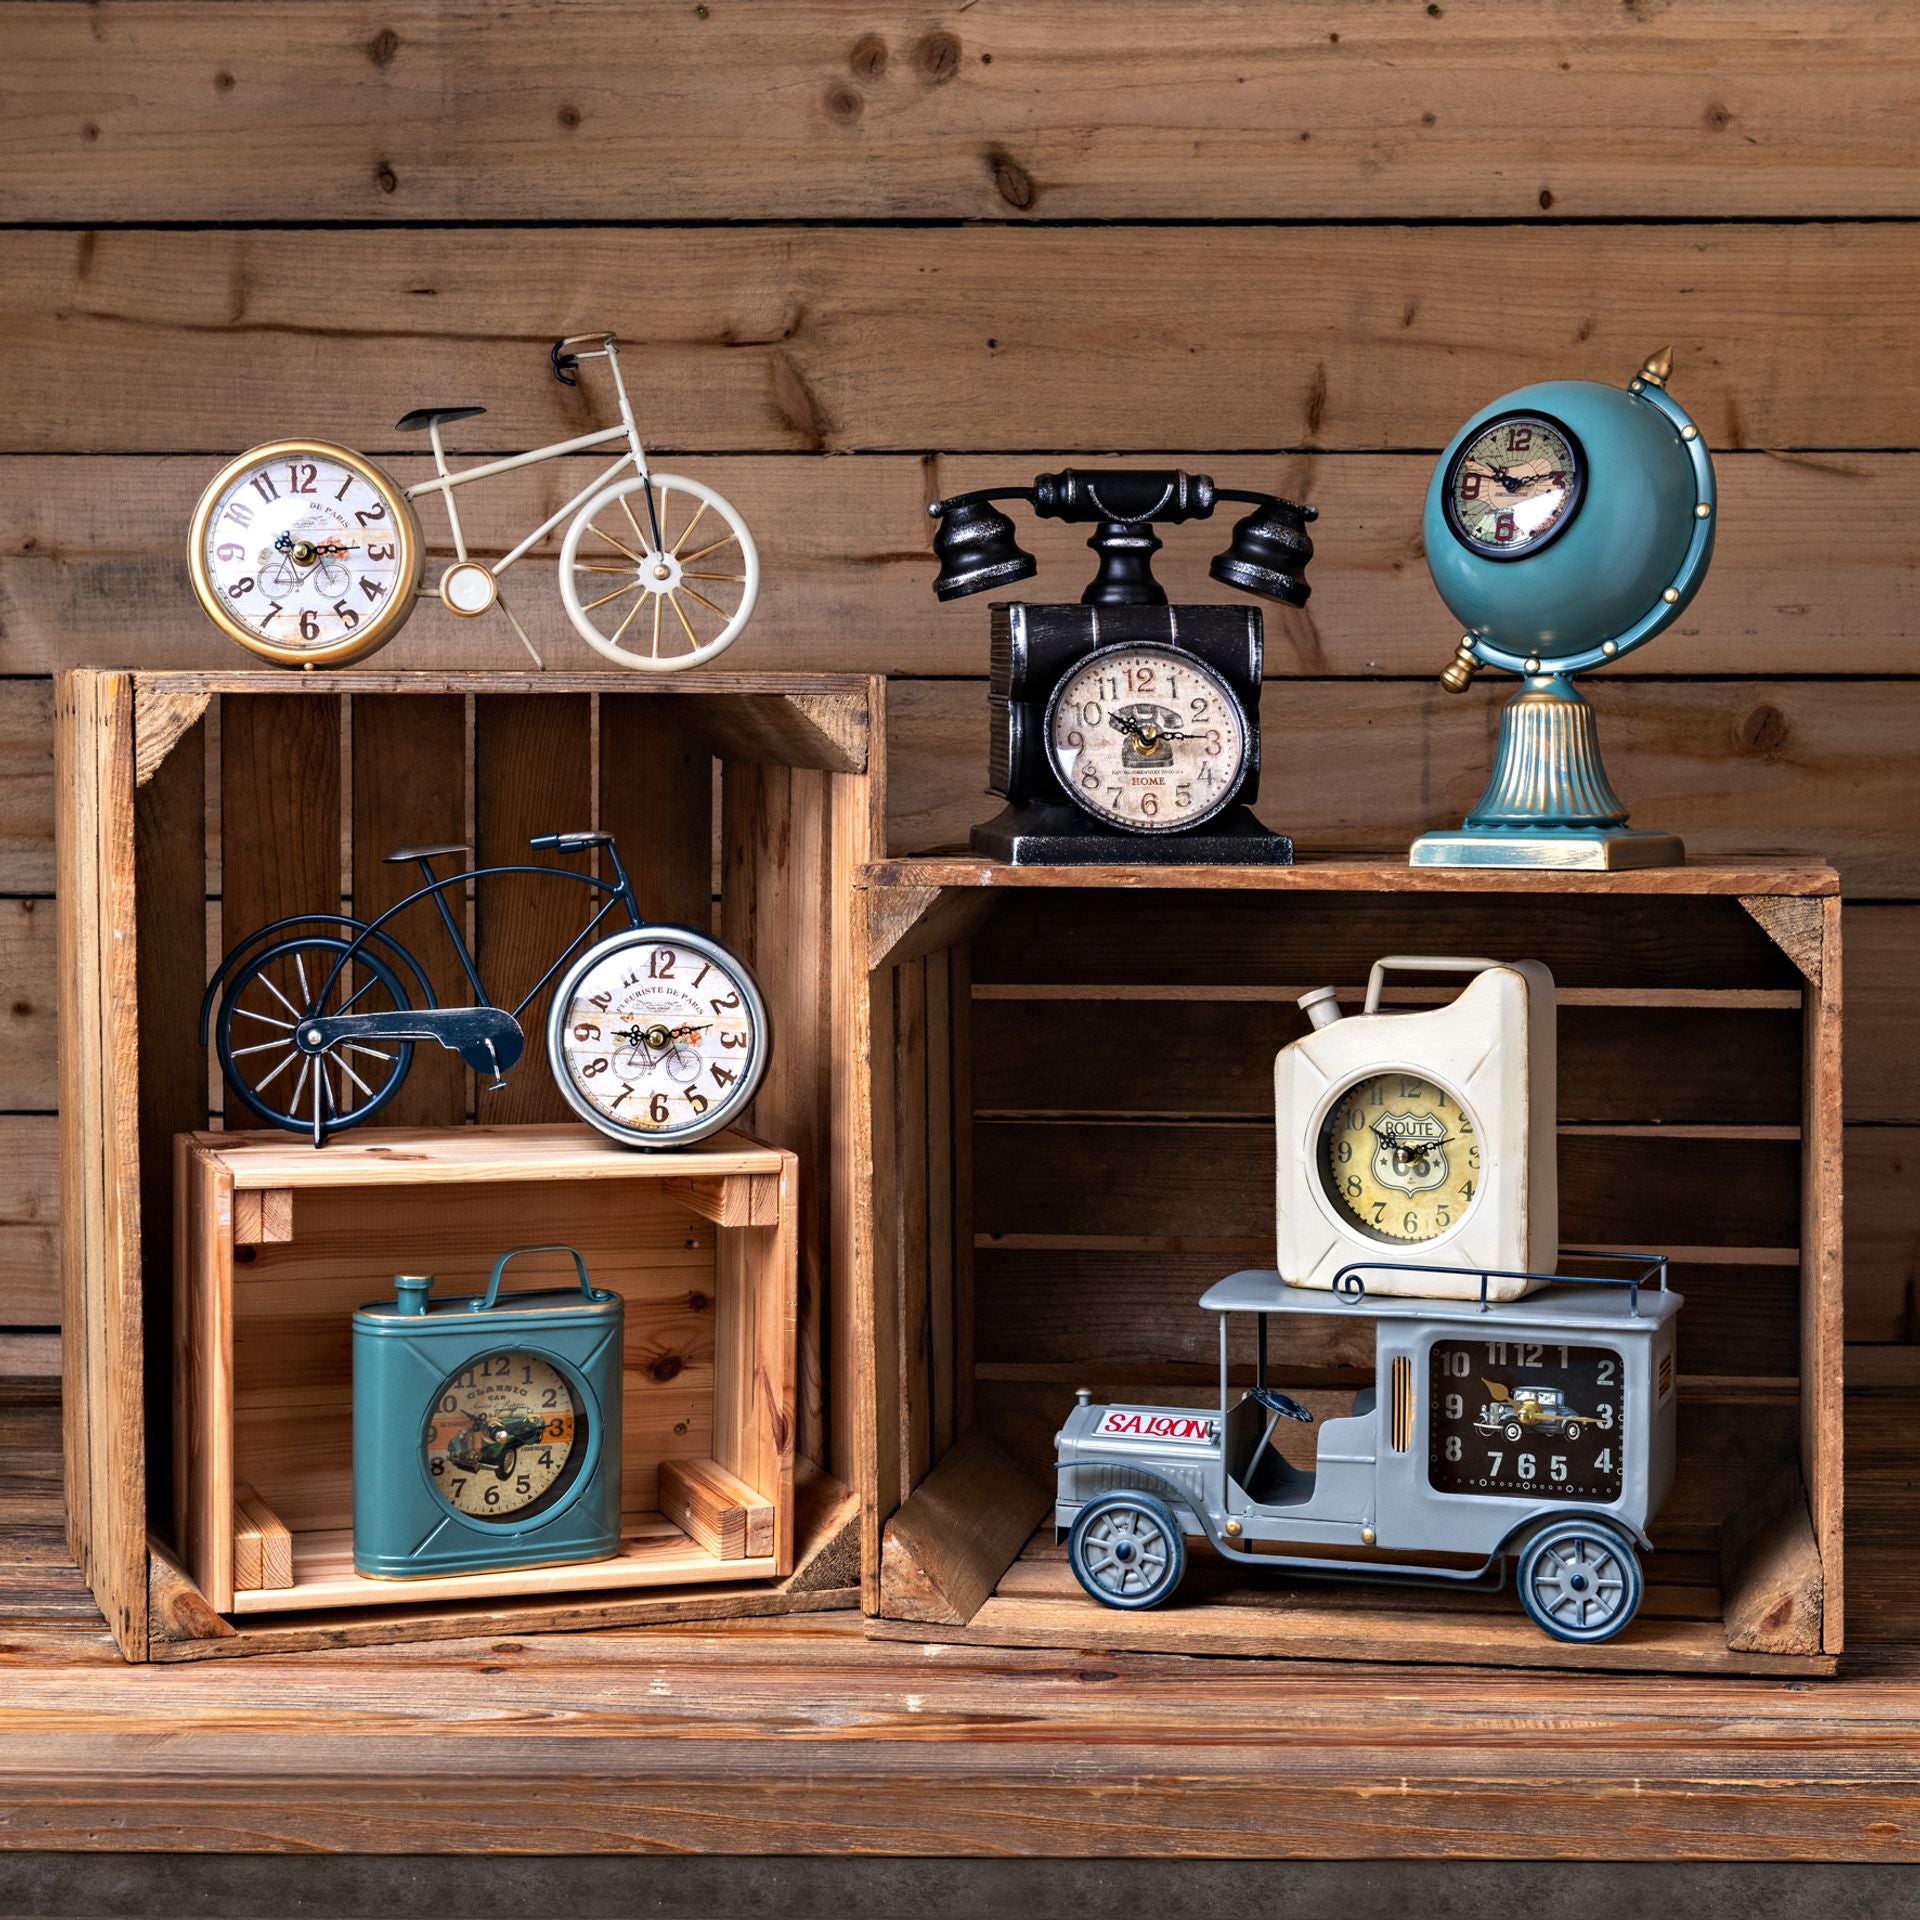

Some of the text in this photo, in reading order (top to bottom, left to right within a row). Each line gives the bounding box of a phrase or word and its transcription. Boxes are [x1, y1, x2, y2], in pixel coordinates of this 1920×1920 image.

[1507, 428, 1532, 451] 12
[250, 471, 281, 504] 11
[289, 464, 317, 493] 12
[334, 474, 354, 501] 1
[1461, 472, 1481, 500] 9
[1550, 471, 1567, 493] 3
[224, 502, 254, 529] 10
[310, 502, 350, 528] DE PARIS
[355, 503, 385, 528] 2
[1495, 513, 1515, 541] 6
[217, 542, 245, 562] 9
[367, 544, 394, 561] 3
[228, 577, 254, 598] 8
[358, 575, 387, 602] 4
[260, 602, 283, 628] 7
[300, 610, 320, 640] 6
[333, 599, 359, 630] 5
[1095, 676, 1119, 701] 11
[1123, 667, 1154, 692] 12
[1167, 675, 1178, 699] 1
[1071, 701, 1102, 727] 10
[1190, 698, 1209, 722] 2
[1068, 731, 1084, 757] 9
[1205, 729, 1222, 756] 3
[1082, 761, 1099, 789] 8
[1132, 777, 1165, 785] HOME
[1197, 761, 1215, 786] 4
[1107, 786, 1123, 809] 7
[1141, 793, 1158, 816] 6
[1175, 783, 1192, 807] 5
[648, 951, 675, 979] 12
[691, 962, 711, 988] 1
[617, 987, 705, 1015] FLEURISTE DE PARIS
[710, 992, 740, 1016] 2
[573, 1023, 601, 1043] 9
[720, 1032, 747, 1049] 3
[582, 1058, 608, 1079] 8
[709, 1062, 737, 1088] 4
[611, 1083, 635, 1109] 7
[683, 1084, 708, 1115] 5
[1369, 1084, 1384, 1105] 11
[1398, 1078, 1422, 1098] 12
[1438, 1085, 1446, 1107] 1
[650, 1093, 669, 1123] 6
[1346, 1110, 1365, 1131] 10
[1385, 1121, 1434, 1135] ROUTE
[1458, 1111, 1473, 1133] 2
[1338, 1141, 1352, 1163] 9
[1469, 1145, 1480, 1170] 3
[1347, 1175, 1363, 1197] 8
[1458, 1180, 1474, 1201] 4
[1372, 1202, 1387, 1224] 7
[1403, 1211, 1418, 1233] 6
[1436, 1205, 1450, 1226] 5
[1439, 1352, 1470, 1377] 10
[1485, 1342, 1507, 1365] 11
[1514, 1343, 1543, 1367] 12
[1559, 1345, 1568, 1369] 1
[480, 1356, 510, 1377] 12
[522, 1366, 533, 1385] 1
[1596, 1360, 1615, 1386] 2
[467, 1385, 528, 1399] CLASSIC
[542, 1389, 557, 1408] 2
[1445, 1394, 1463, 1420] 9
[1596, 1404, 1613, 1430] 3
[549, 1418, 563, 1437] 3
[1104, 1414, 1208, 1438] SALOON
[538, 1450, 553, 1469] 4
[1446, 1436, 1462, 1461] 8
[1594, 1448, 1613, 1473] 4
[431, 1457, 444, 1476] 8
[1487, 1451, 1503, 1476] 7
[1518, 1453, 1537, 1479] 6
[1550, 1456, 1567, 1481] 5
[451, 1478, 467, 1498] 7
[484, 1485, 499, 1505] 6
[516, 1474, 530, 1494] 5
